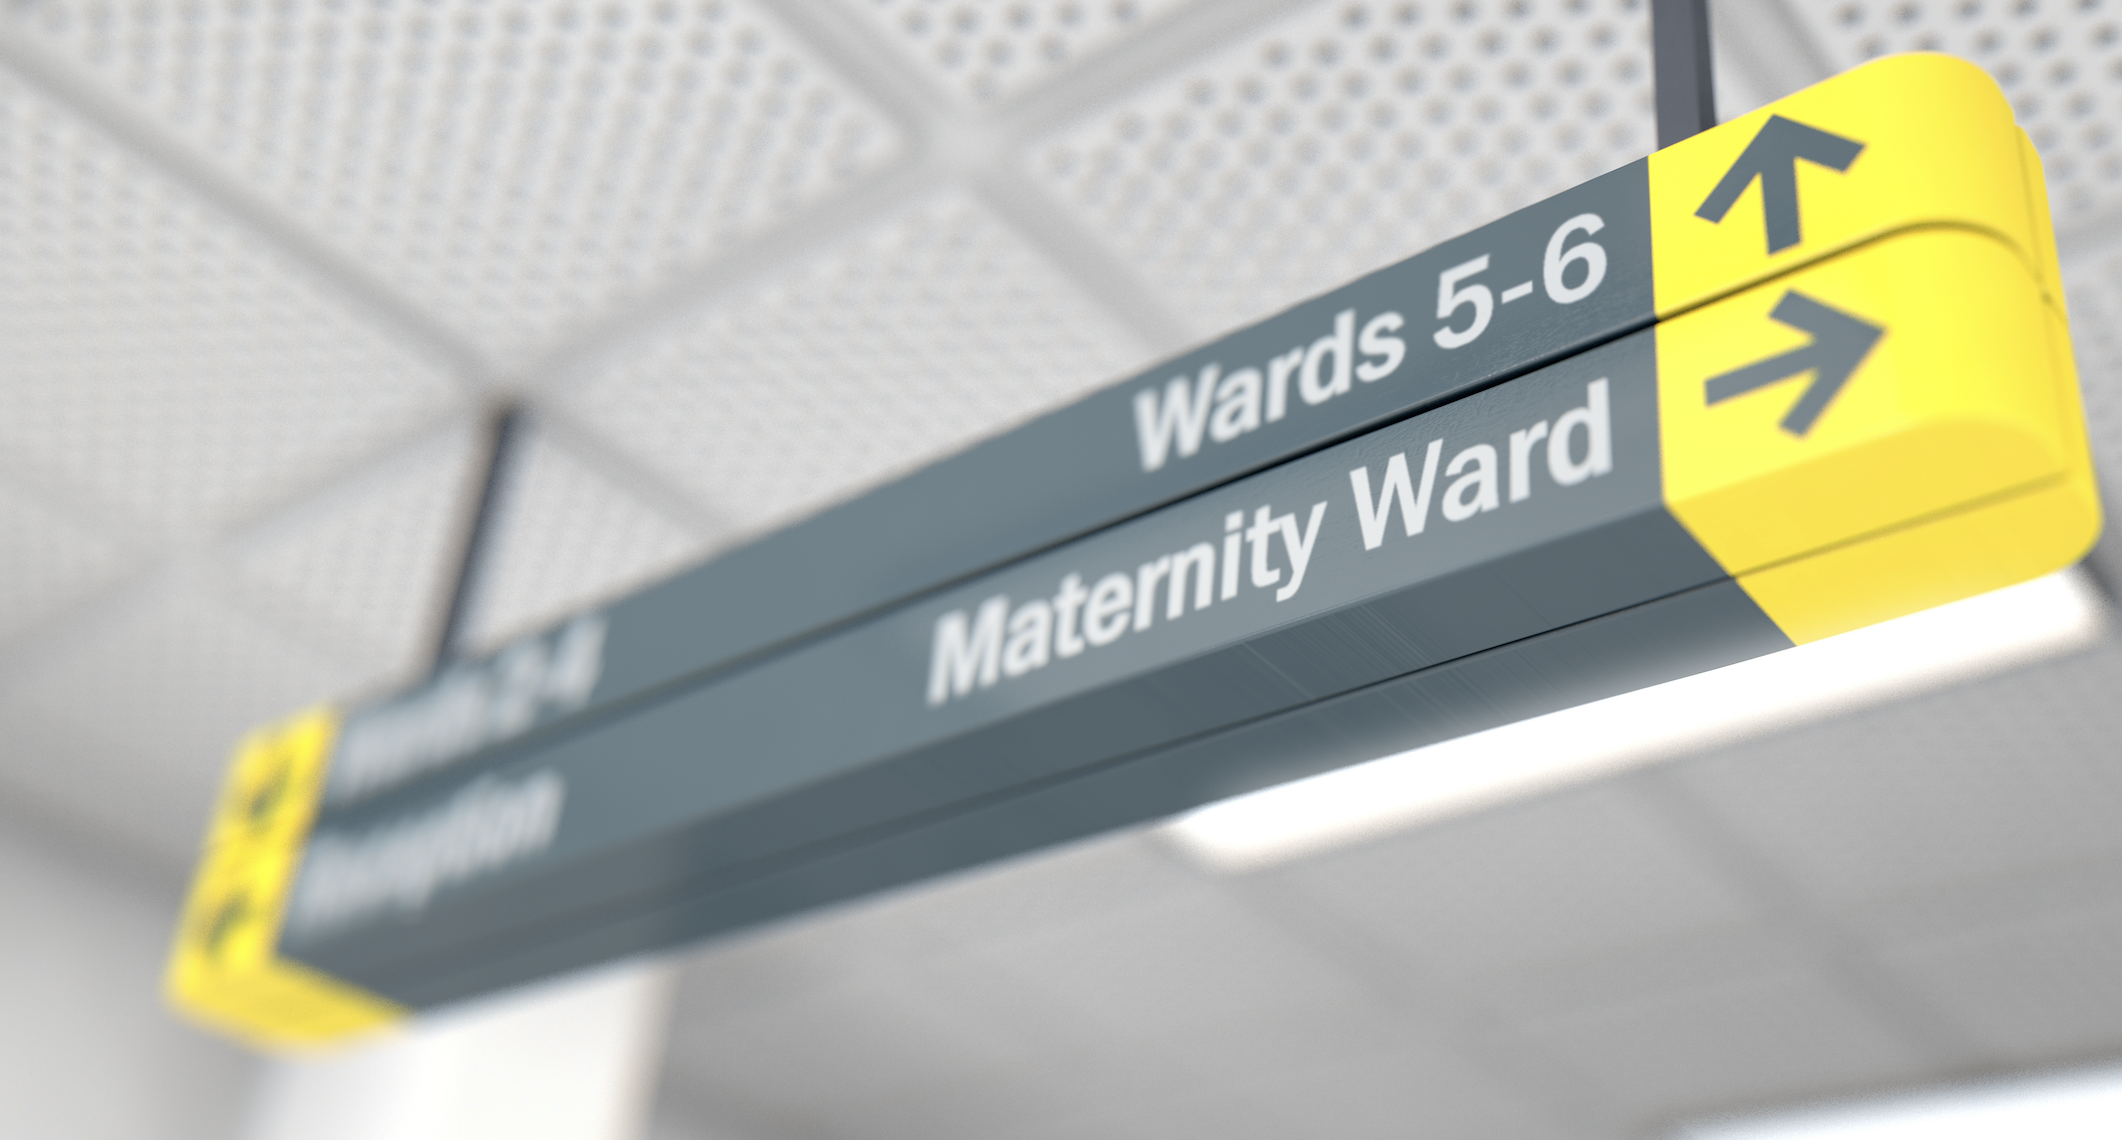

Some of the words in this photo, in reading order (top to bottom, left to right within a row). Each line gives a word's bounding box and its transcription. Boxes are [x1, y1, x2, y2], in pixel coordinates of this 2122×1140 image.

[1134, 308, 1406, 472] Wards
[1432, 212, 1607, 350] 5-6
[927, 500, 1328, 707] Maternity
[1349, 377, 1612, 552] Ward
